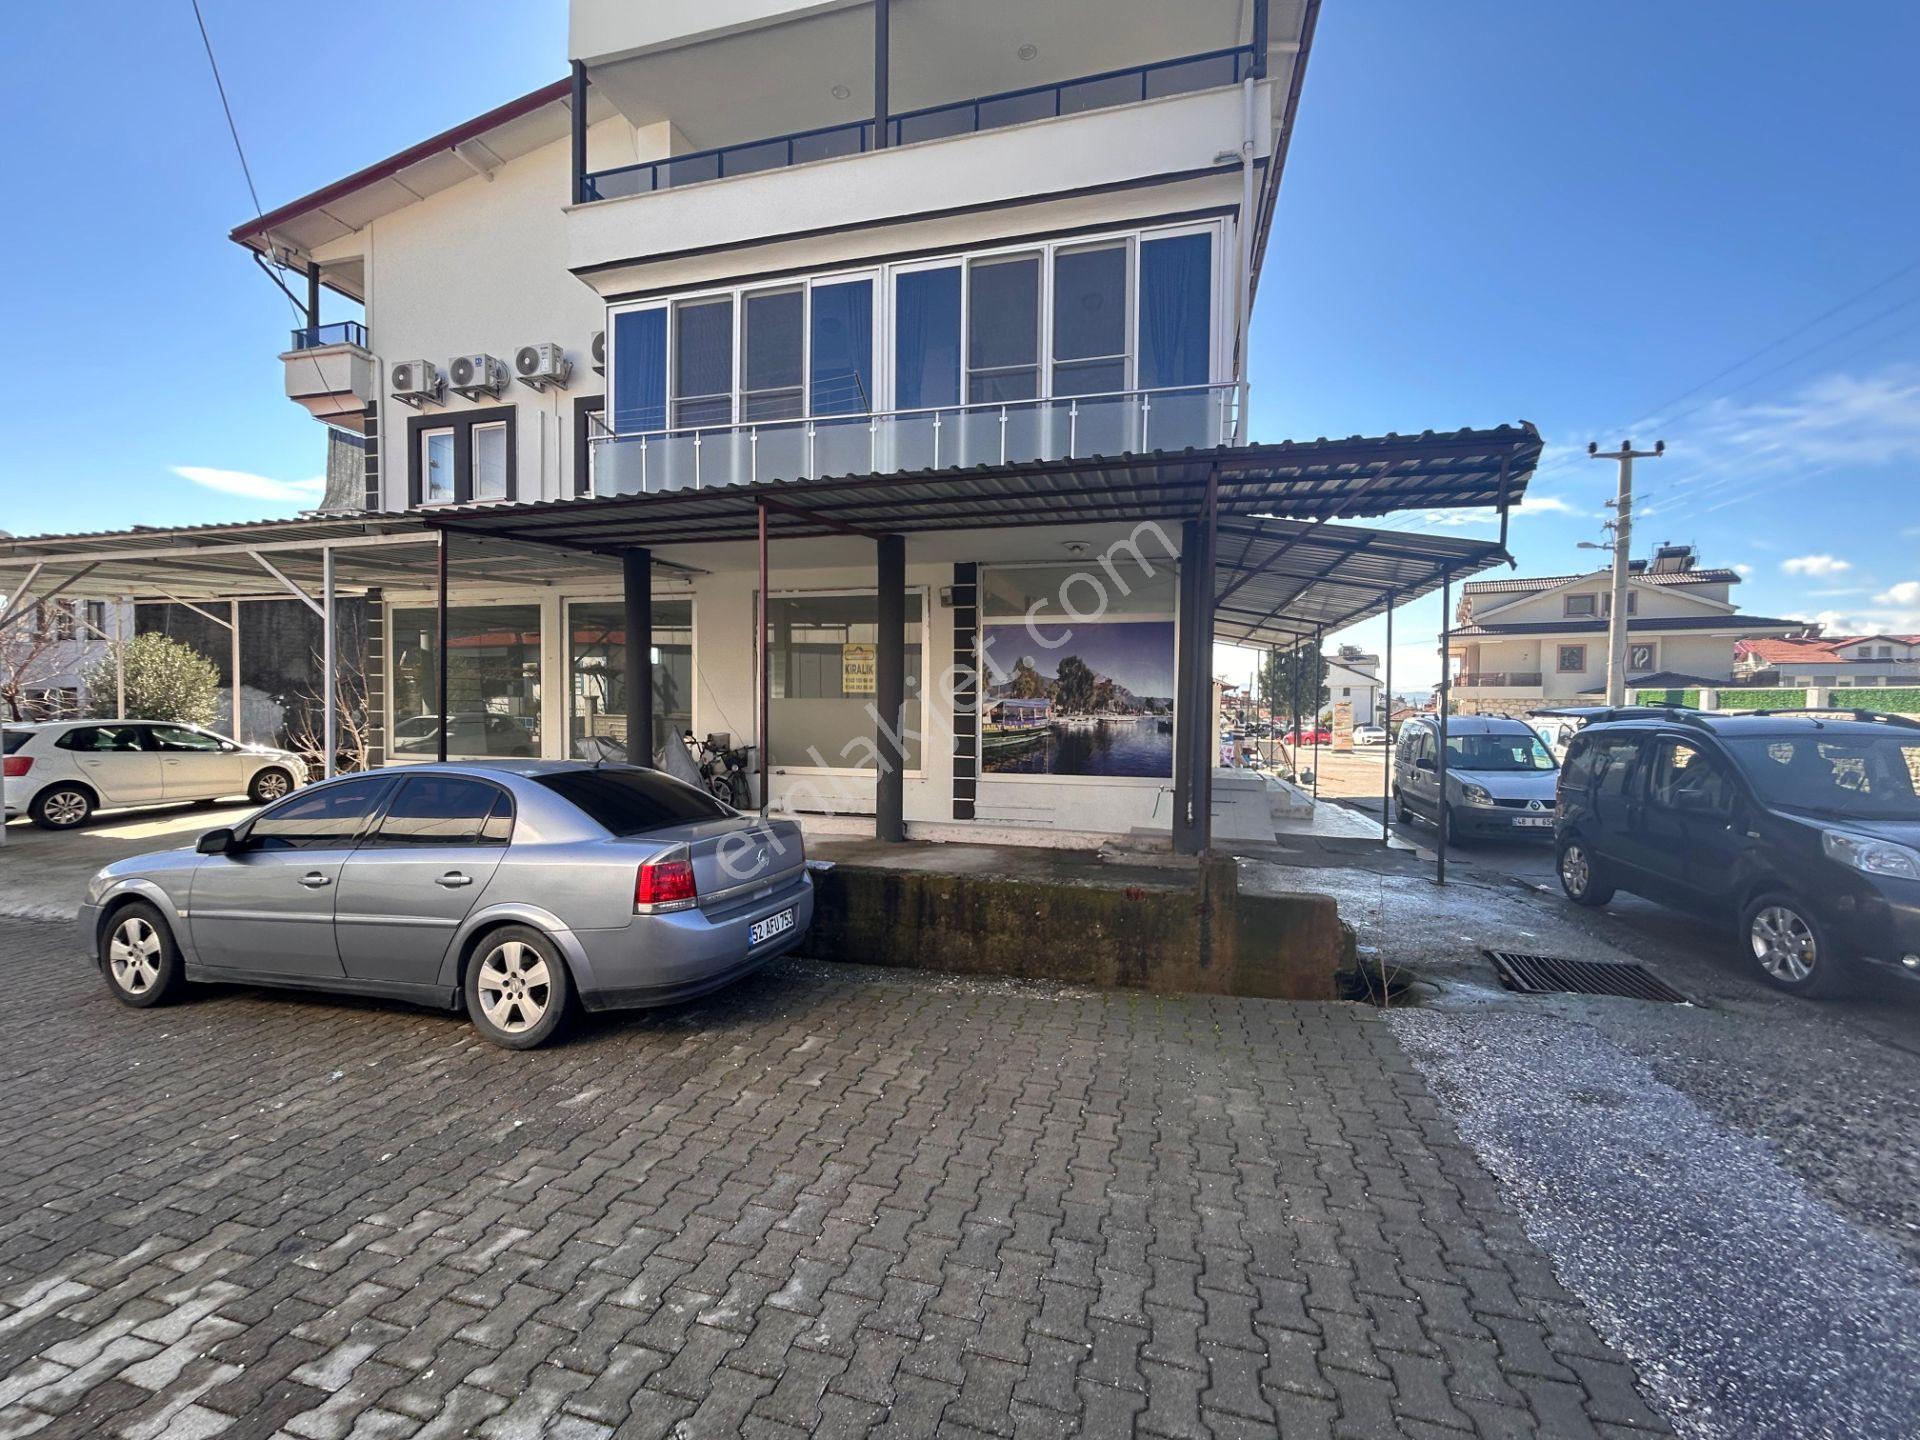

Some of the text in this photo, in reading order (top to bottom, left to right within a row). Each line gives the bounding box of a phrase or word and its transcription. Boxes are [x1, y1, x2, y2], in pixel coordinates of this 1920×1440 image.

[845, 663, 874, 674] KIRALIK
[752, 910, 793, 942] 52 AFU 753
